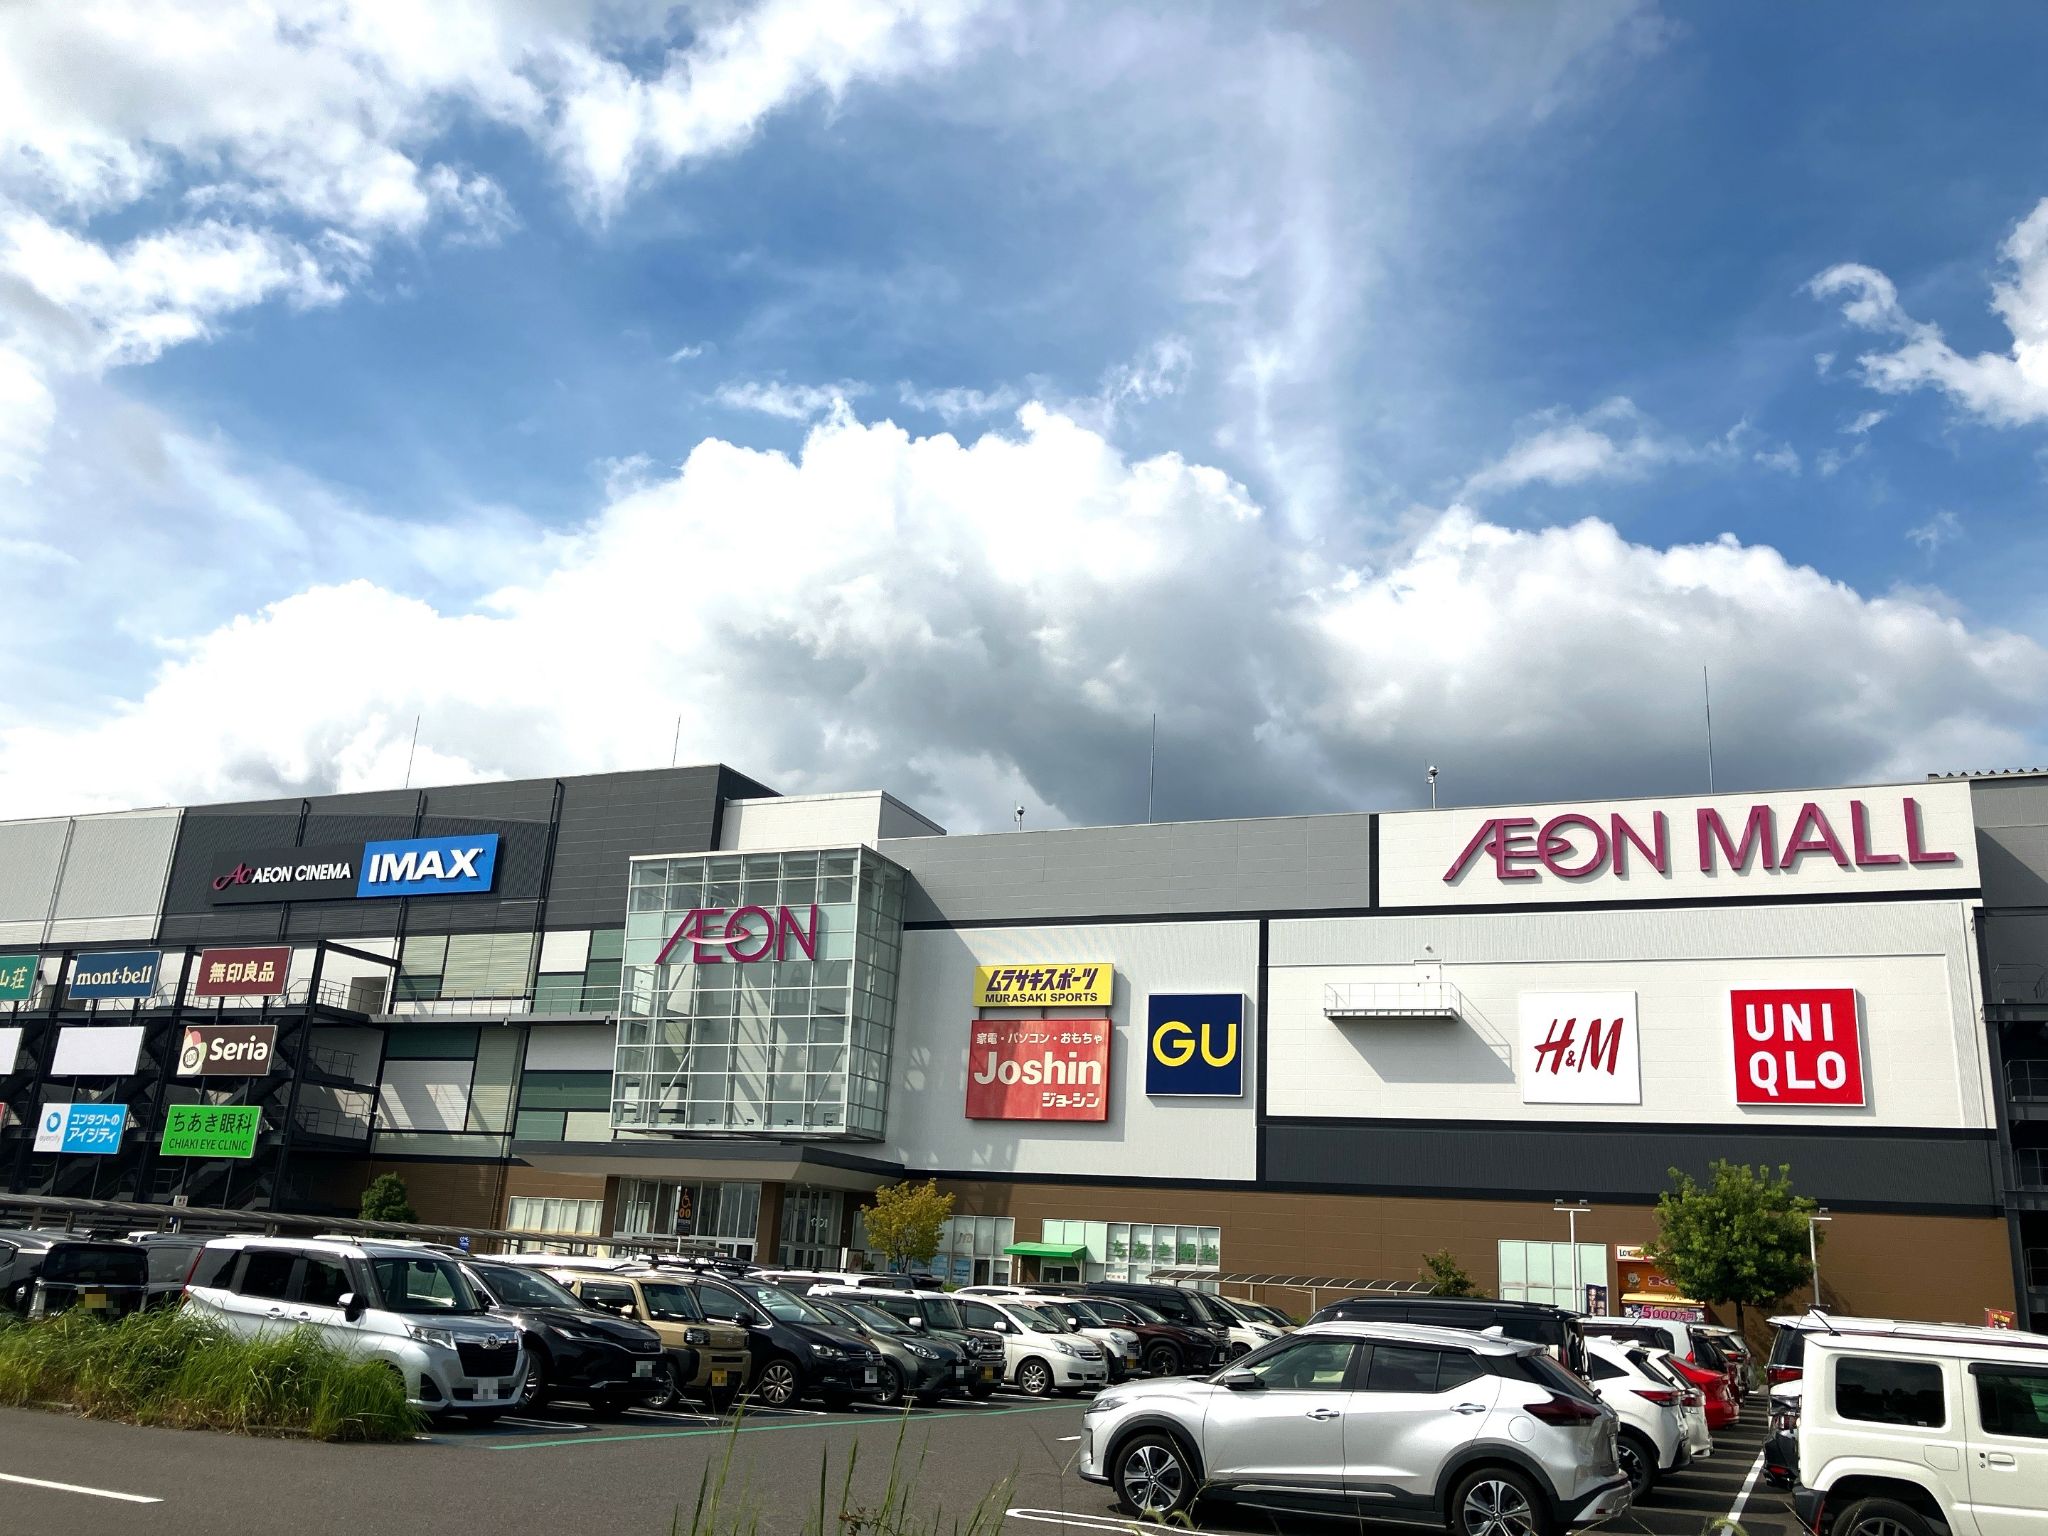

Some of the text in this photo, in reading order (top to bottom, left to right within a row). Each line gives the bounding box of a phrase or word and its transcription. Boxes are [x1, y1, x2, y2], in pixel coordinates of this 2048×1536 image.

[1697, 797, 1957, 872] MALL
[251, 866, 292, 884] AEON
[294, 862, 351, 882] CINEMA
[368, 848, 484, 883] IMAX
[208, 961, 275, 983] 無印良品
[986, 967, 1099, 992] ムラサキスポーツ
[985, 992, 1098, 1003] MURASAKI SPORTS
[1745, 1003, 1834, 1042] UNI
[209, 1035, 268, 1061] Seria
[1152, 1020, 1237, 1068] GU
[1534, 1017, 1624, 1075] H&M
[974, 1051, 1102, 1085] Joshin
[1749, 1050, 1847, 1096] QLO
[1042, 1092, 1100, 1108] ジョーシン
[70, 1114, 120, 1126] コンタクトの
[173, 1111, 252, 1134] ちあき眼科
[67, 1127, 117, 1143] アイシティ
[169, 1138, 249, 1151] CHIAKI EYE CLINIC
